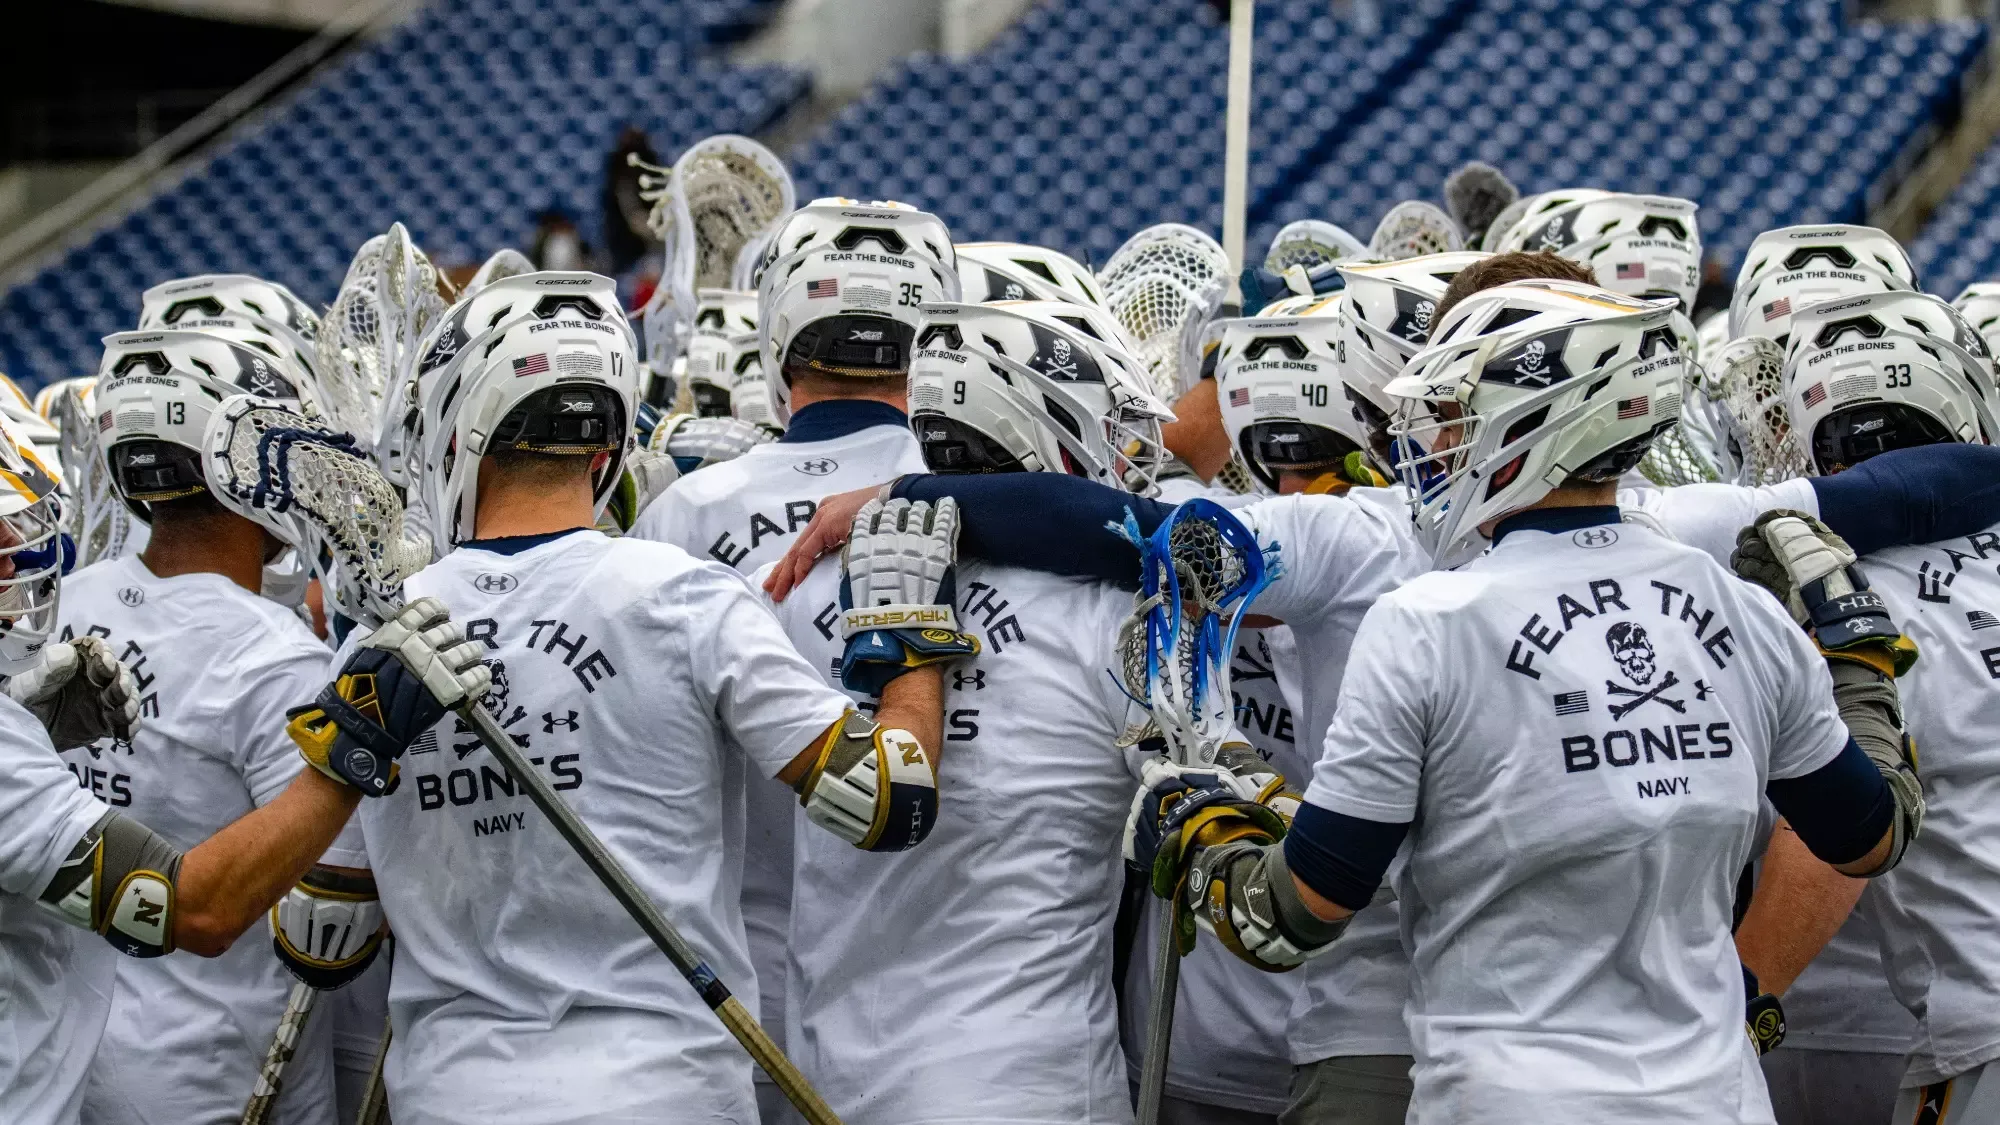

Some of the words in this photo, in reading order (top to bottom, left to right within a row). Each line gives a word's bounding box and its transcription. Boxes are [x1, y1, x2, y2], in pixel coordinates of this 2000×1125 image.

[841, 211, 900, 219] cascade
[1789, 230, 1847, 240] cascade
[824, 253, 852, 262] FEAR
[855, 253, 876, 262] THE
[880, 255, 914, 269] BONES
[535, 278, 592, 286] cascade
[1776, 273, 1803, 285] FEAR
[1806, 271, 1826, 279] THE
[1830, 271, 1866, 282] BONES
[898, 282, 922, 307] 35
[1816, 298, 1871, 315] cascade
[529, 322, 559, 335] FEAR
[561, 320, 581, 329] THE
[584, 321, 615, 335] BONES
[118, 335, 164, 345] cascade
[938, 350, 967, 363] BONES
[1808, 351, 1832, 366] FEAR
[1835, 345, 1854, 355] THE
[1857, 342, 1895, 351] BONES
[1238, 363, 1259, 374] FEAR
[1261, 361, 1279, 369] THE
[1282, 361, 1318, 372] BONES
[1632, 363, 1655, 378] FEAR
[1656, 358, 1669, 368] THE
[1884, 364, 1912, 388] 33
[106, 379, 124, 392] FEAR
[127, 376, 145, 385] THE
[146, 376, 179, 388] BONES
[953, 380, 966, 405] 9
[1302, 383, 1328, 407] 40
[167, 402, 185, 424] 13
[708, 500, 817, 568] EAR
[846, 610, 948, 629] MAVERIK
[961, 581, 1026, 654] THE
[1506, 578, 1631, 680] FEAR
[1651, 579, 1736, 670] THE
[526, 619, 617, 693] THE
[1562, 722, 1733, 773] BONES
[68, 762, 132, 808] NES
